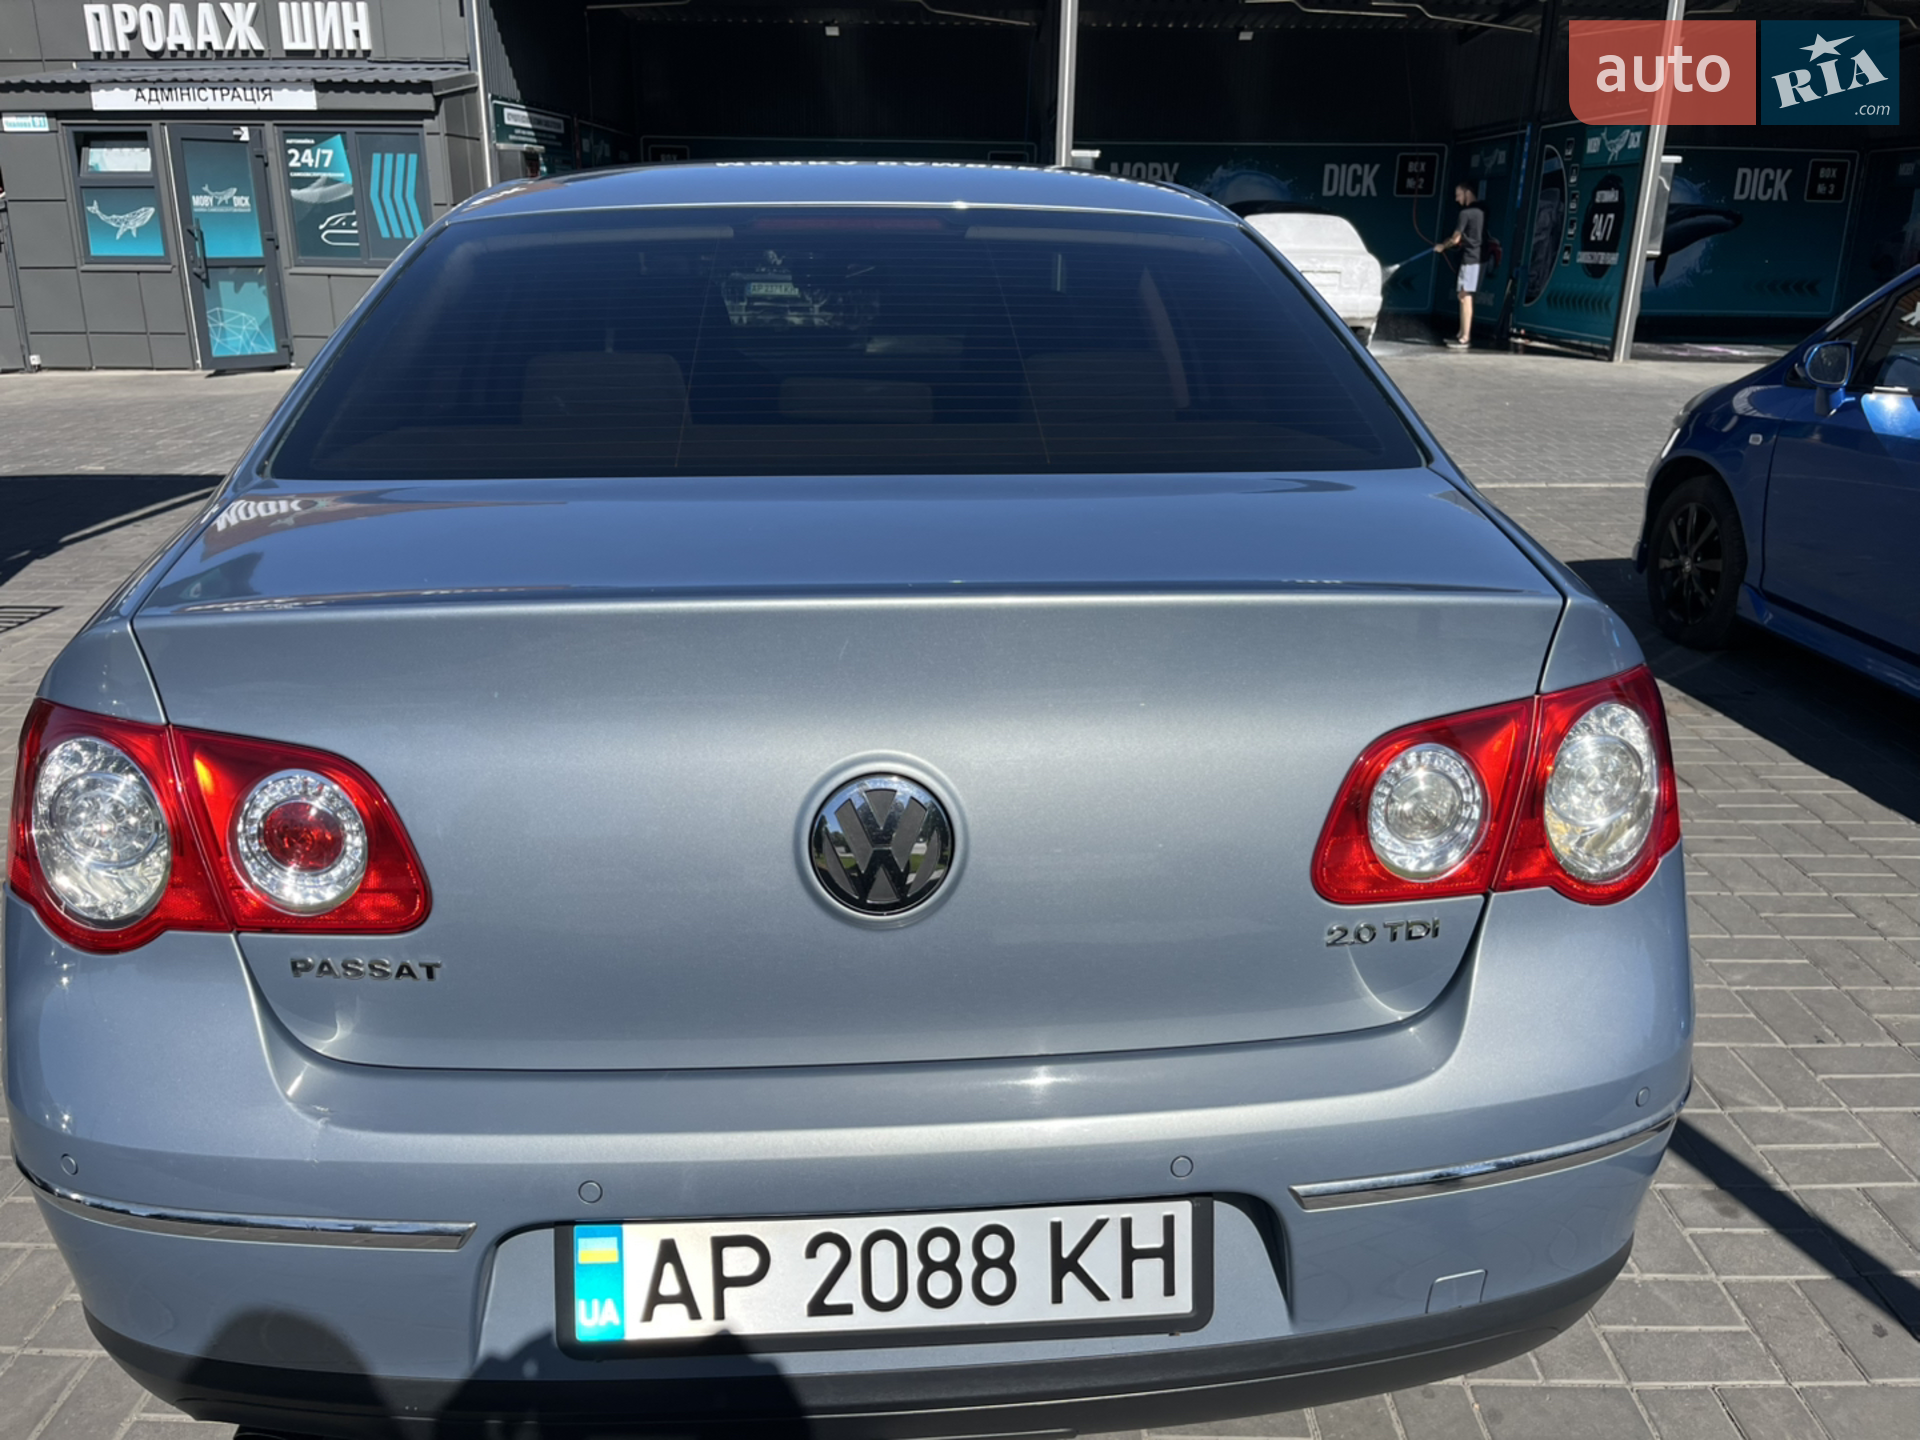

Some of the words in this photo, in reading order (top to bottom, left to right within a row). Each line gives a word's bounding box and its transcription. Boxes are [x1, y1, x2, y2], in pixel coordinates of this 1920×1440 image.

[83, 2, 265, 52] ПРОДАЖ
[278, 2, 372, 50] ШИН
[134, 86, 273, 105] АДМІНІСТРАЦІЯ
[287, 148, 334, 168] 24/7
[1322, 163, 1381, 197] DICK
[1733, 167, 1792, 201] DICK
[1819, 167, 1838, 179] BOX
[192, 195, 214, 207] MOBY
[233, 195, 251, 207] DICK
[1590, 213, 1615, 242] 24/7
[1383, 917, 1440, 943] TDI
[290, 956, 442, 982] PASSAT
[640, 1234, 772, 1322] AP
[804, 1223, 1018, 1317] 2088
[1049, 1213, 1176, 1305] KH
[579, 1299, 621, 1328] UA
